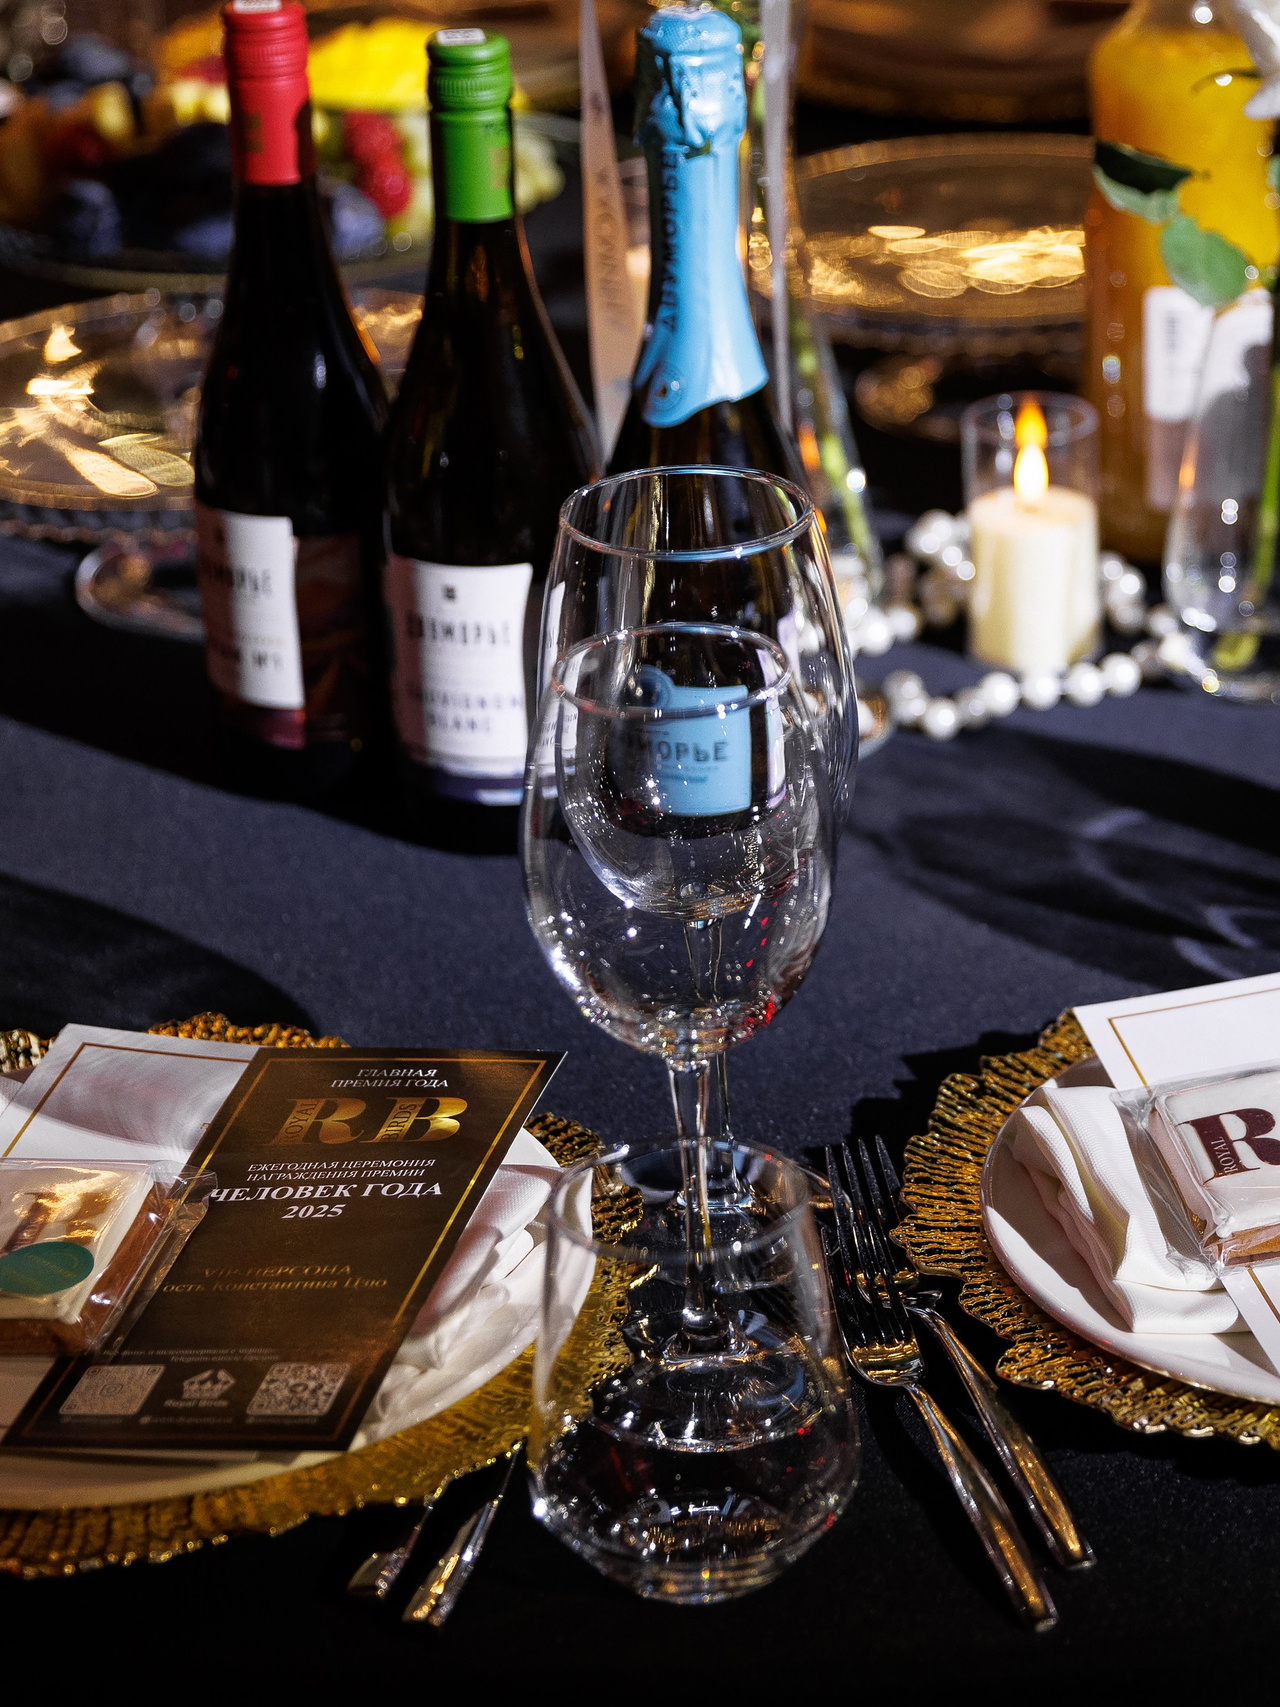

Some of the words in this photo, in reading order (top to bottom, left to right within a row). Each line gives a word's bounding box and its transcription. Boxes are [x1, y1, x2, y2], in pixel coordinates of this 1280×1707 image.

[357, 1069, 438, 1077] ГЛАВНАЯ
[331, 1079, 401, 1088] ПРЕМИЯ
[404, 1079, 449, 1088] ГОДА
[264, 1096, 468, 1146] RB
[381, 1102, 418, 1141] BIRDS
[1211, 1136, 1239, 1174] ROYAL
[247, 1161, 340, 1173] ЕЖЕГОДНАЯ
[342, 1159, 436, 1169] ЦЕРЕМОНИЯ
[246, 1170, 358, 1182] НАГРАЖДЕНИЯ
[360, 1169, 426, 1178] ПРЕМИИ
[210, 1184, 358, 1202] ЧЕЛОВЕК
[361, 1182, 443, 1199] ГОДА
[282, 1204, 347, 1219] 2025
[162, 1283, 206, 1293] ость
